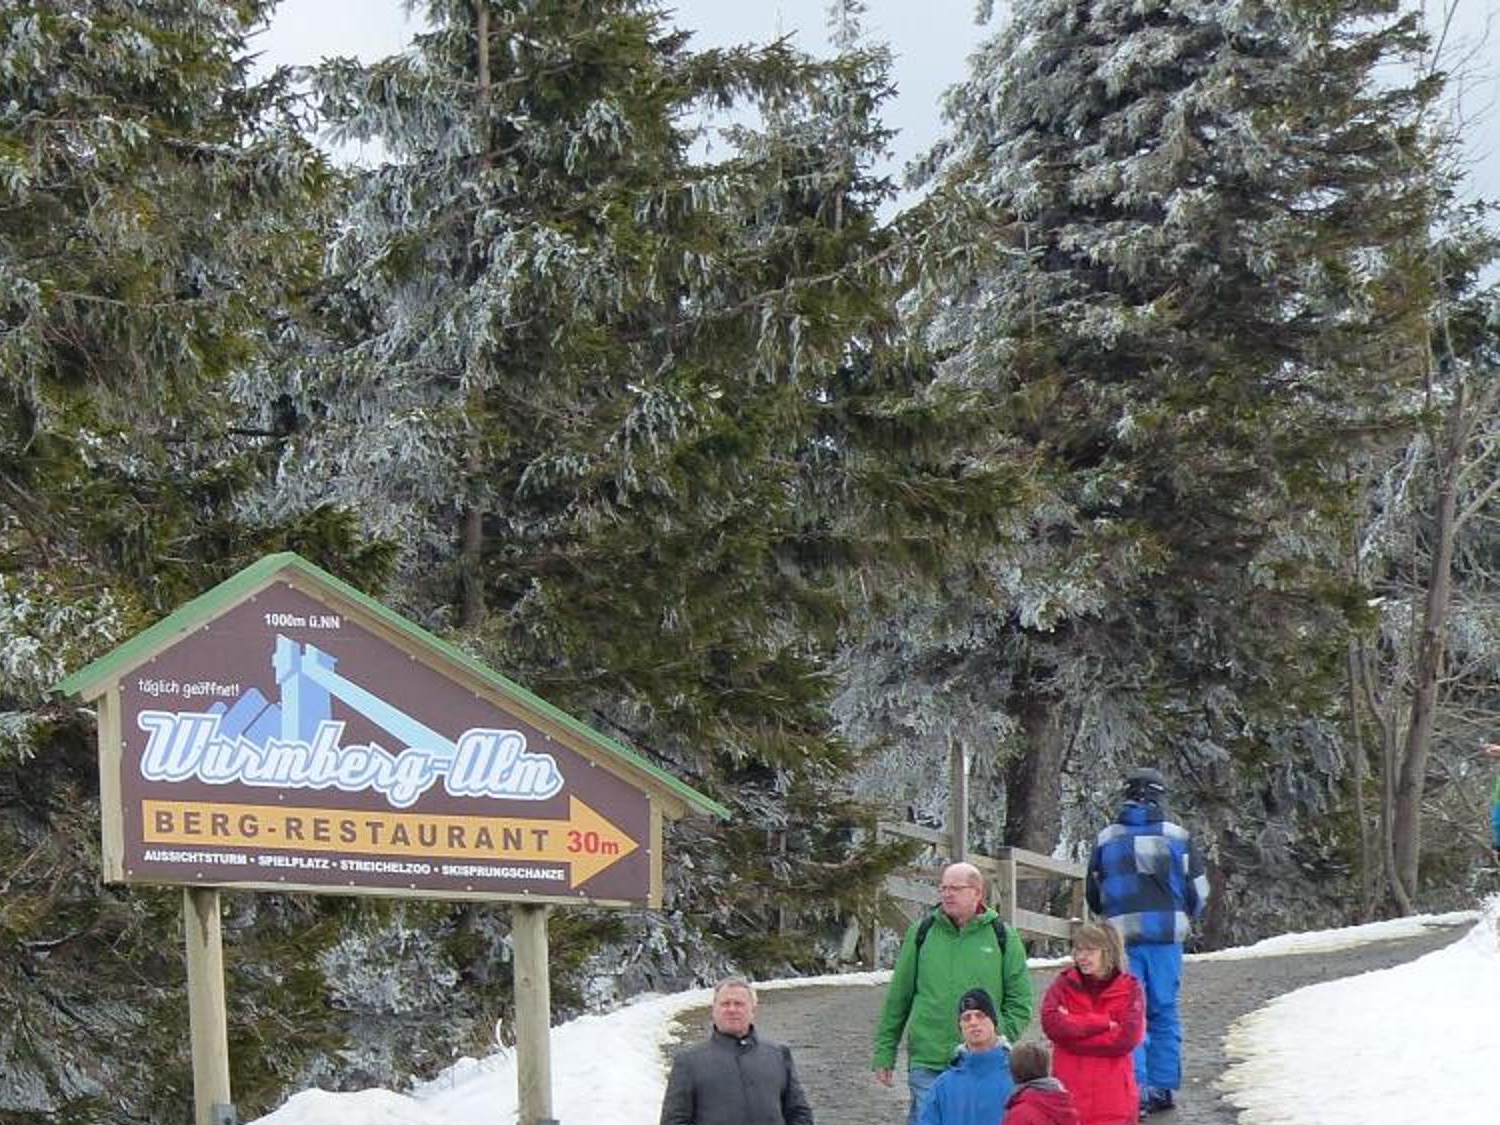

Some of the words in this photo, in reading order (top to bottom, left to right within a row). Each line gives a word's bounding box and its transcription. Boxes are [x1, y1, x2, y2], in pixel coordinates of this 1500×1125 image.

[264, 613, 306, 627] 1000m
[138, 678, 180, 697] täglich
[183, 681, 239, 698] geöffnet!
[155, 810, 549, 851] BERG-RESTAURANT
[566, 830, 619, 855] 30m
[143, 850, 248, 866] AUSSICHTSTURM
[257, 854, 331, 870] SPIELPLATZ
[340, 859, 431, 875] STREICHELZOO
[442, 864, 565, 881] SKISPRUNGSCHANZE
